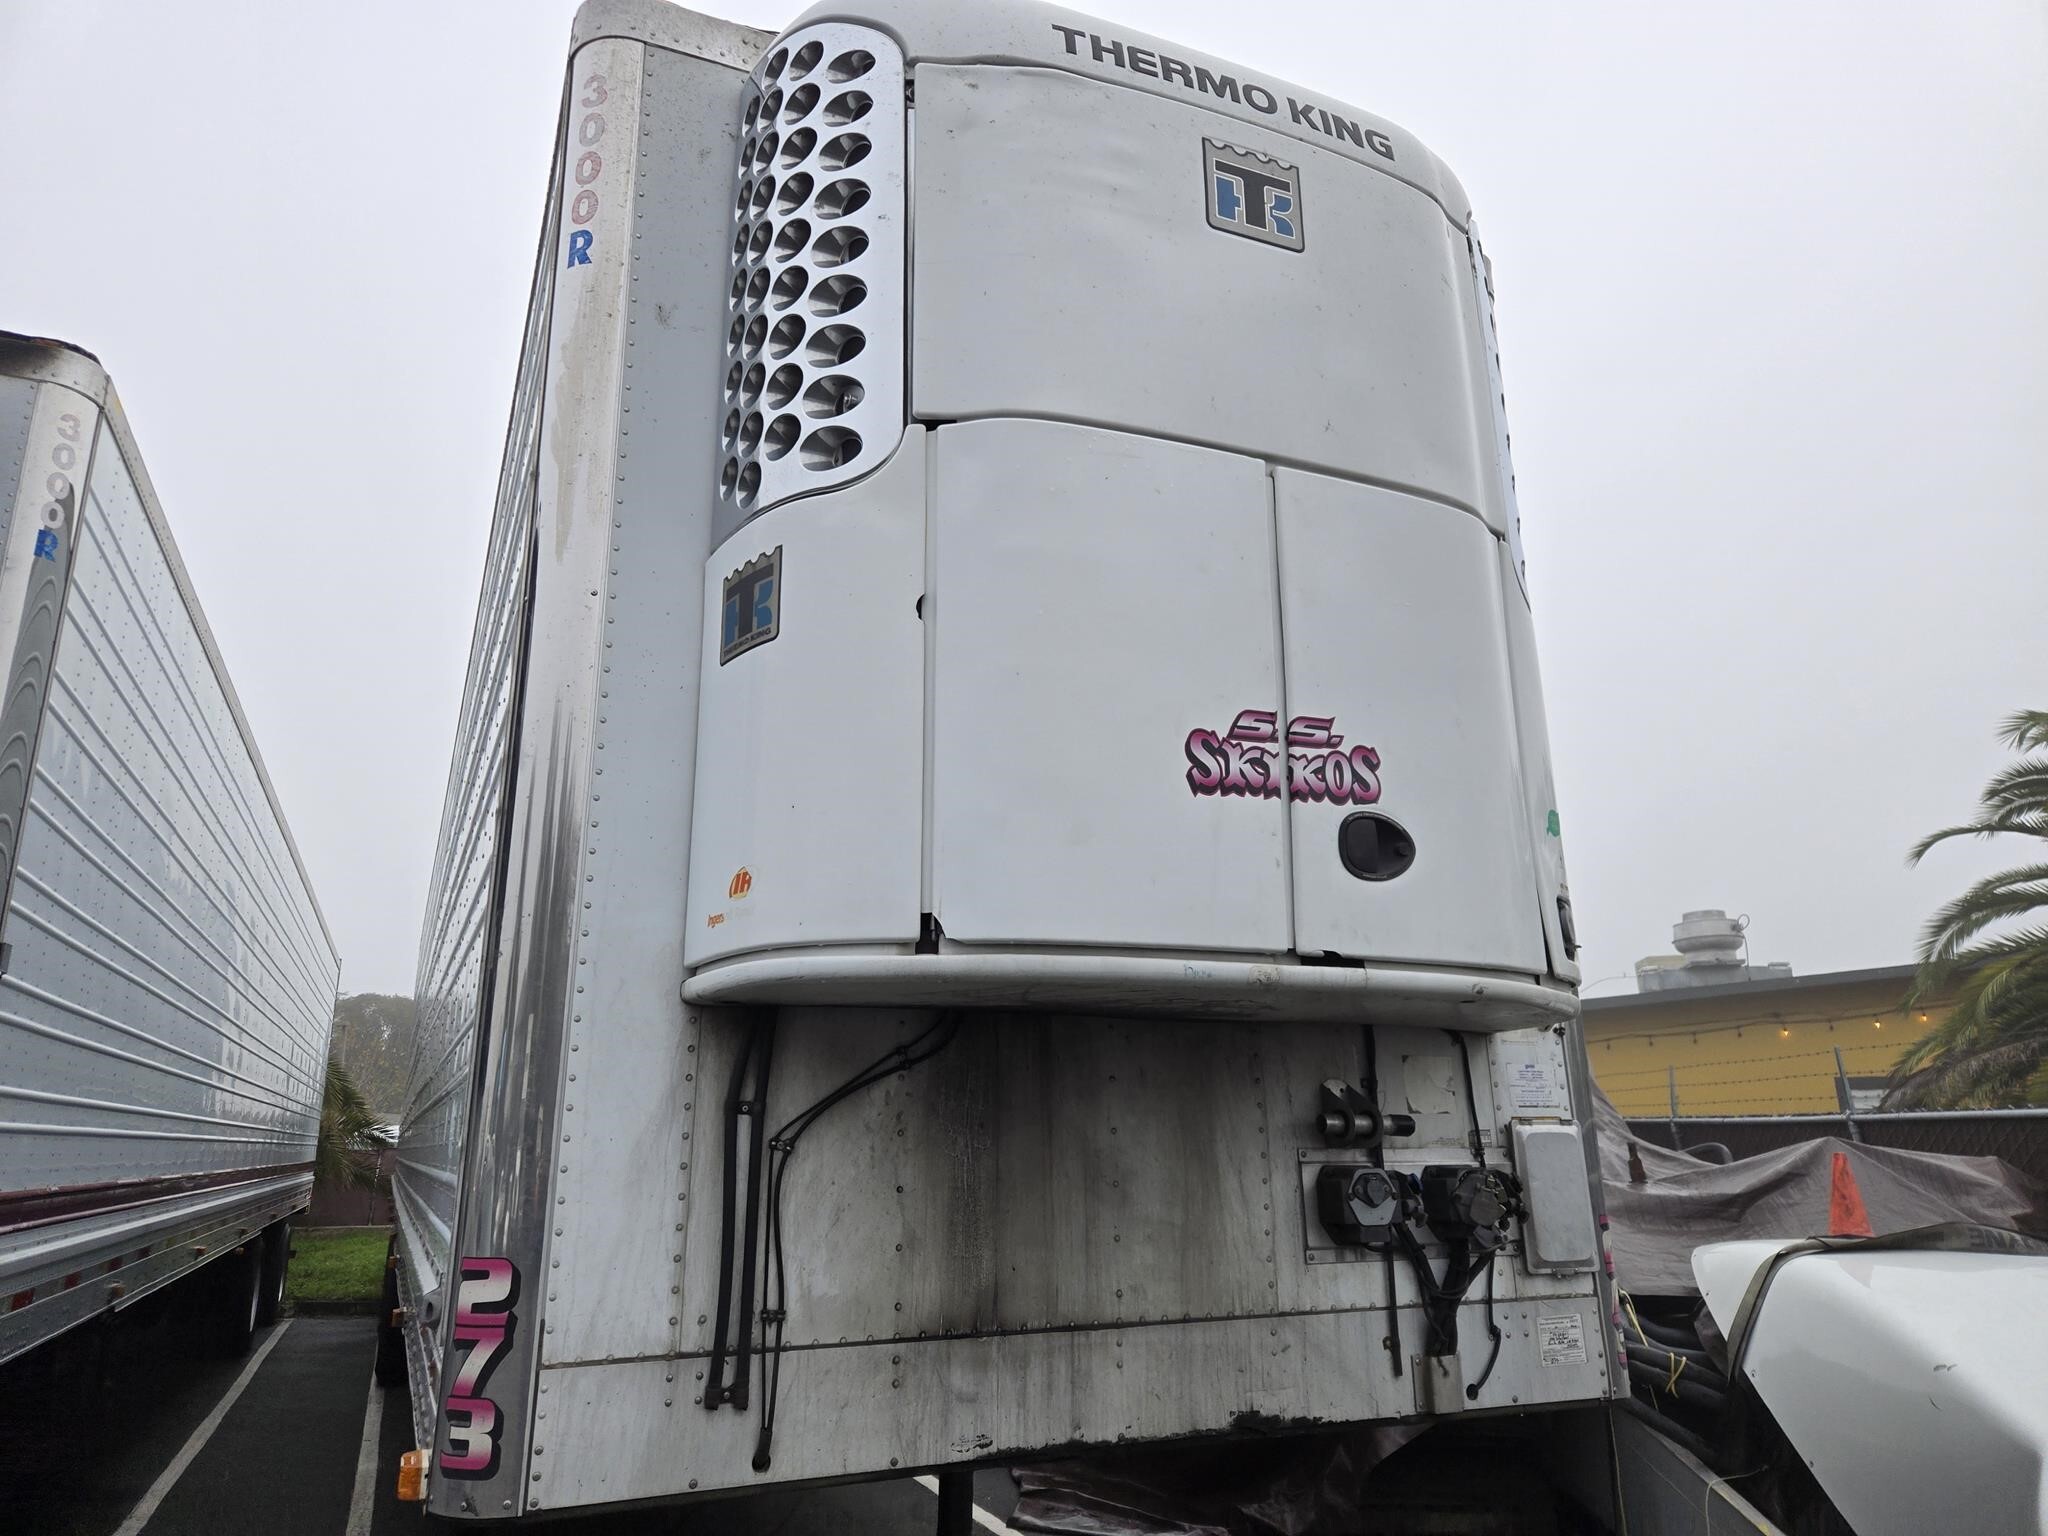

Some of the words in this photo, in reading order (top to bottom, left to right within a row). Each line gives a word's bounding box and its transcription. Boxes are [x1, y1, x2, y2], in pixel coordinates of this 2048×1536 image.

[1052, 24, 1279, 115] THERMO
[1287, 96, 1397, 162] KING
[1184, 726, 1382, 806] SKIKOS
[439, 1256, 521, 1482] 273
